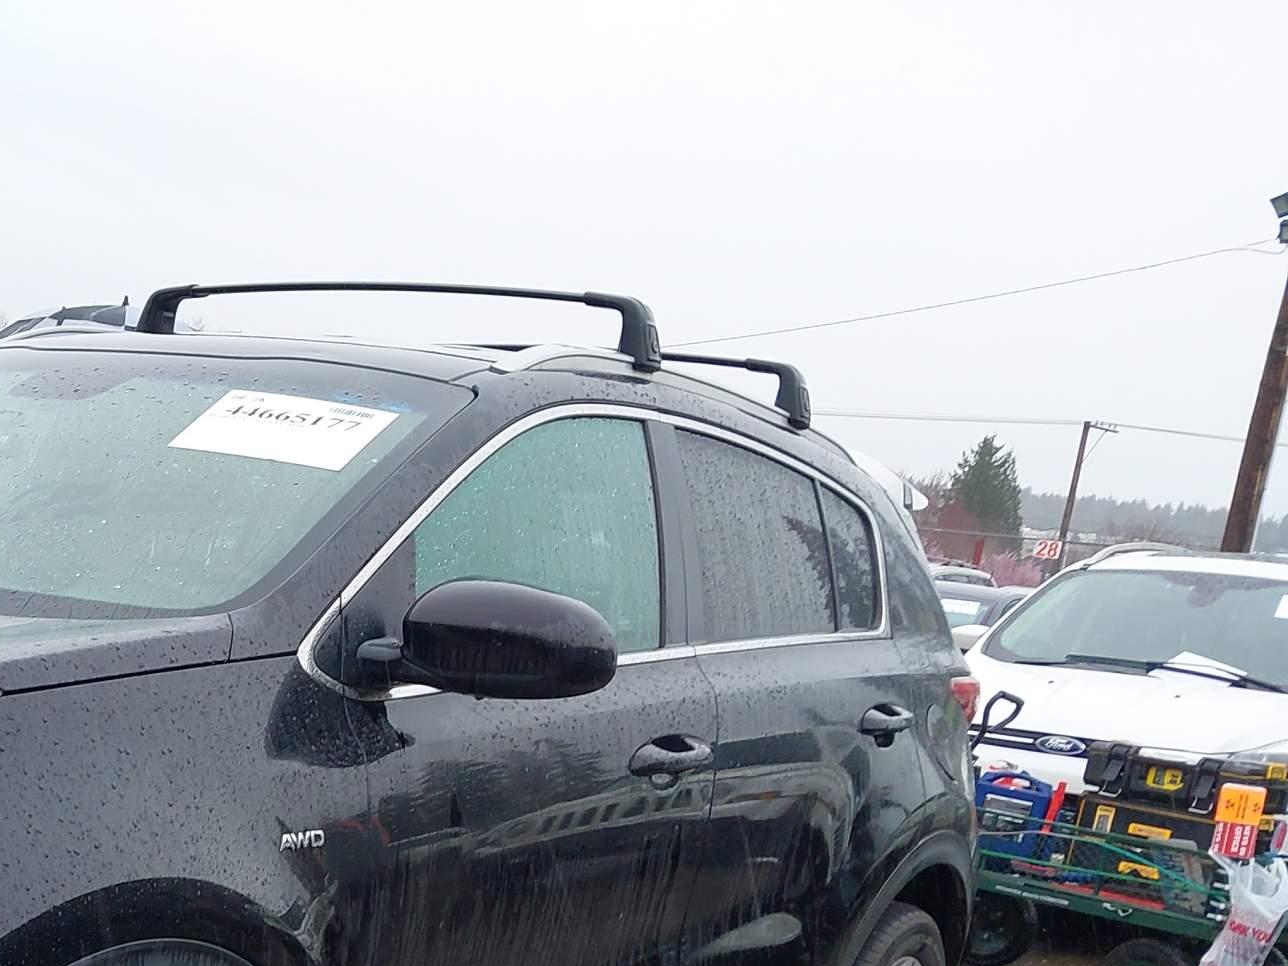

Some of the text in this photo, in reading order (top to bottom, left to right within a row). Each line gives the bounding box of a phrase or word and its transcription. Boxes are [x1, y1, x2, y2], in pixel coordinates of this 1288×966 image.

[226, 405, 362, 431] 44665177
[1035, 541, 1059, 557] 28
[1044, 737, 1074, 751] Ford
[279, 829, 325, 852] AWD
